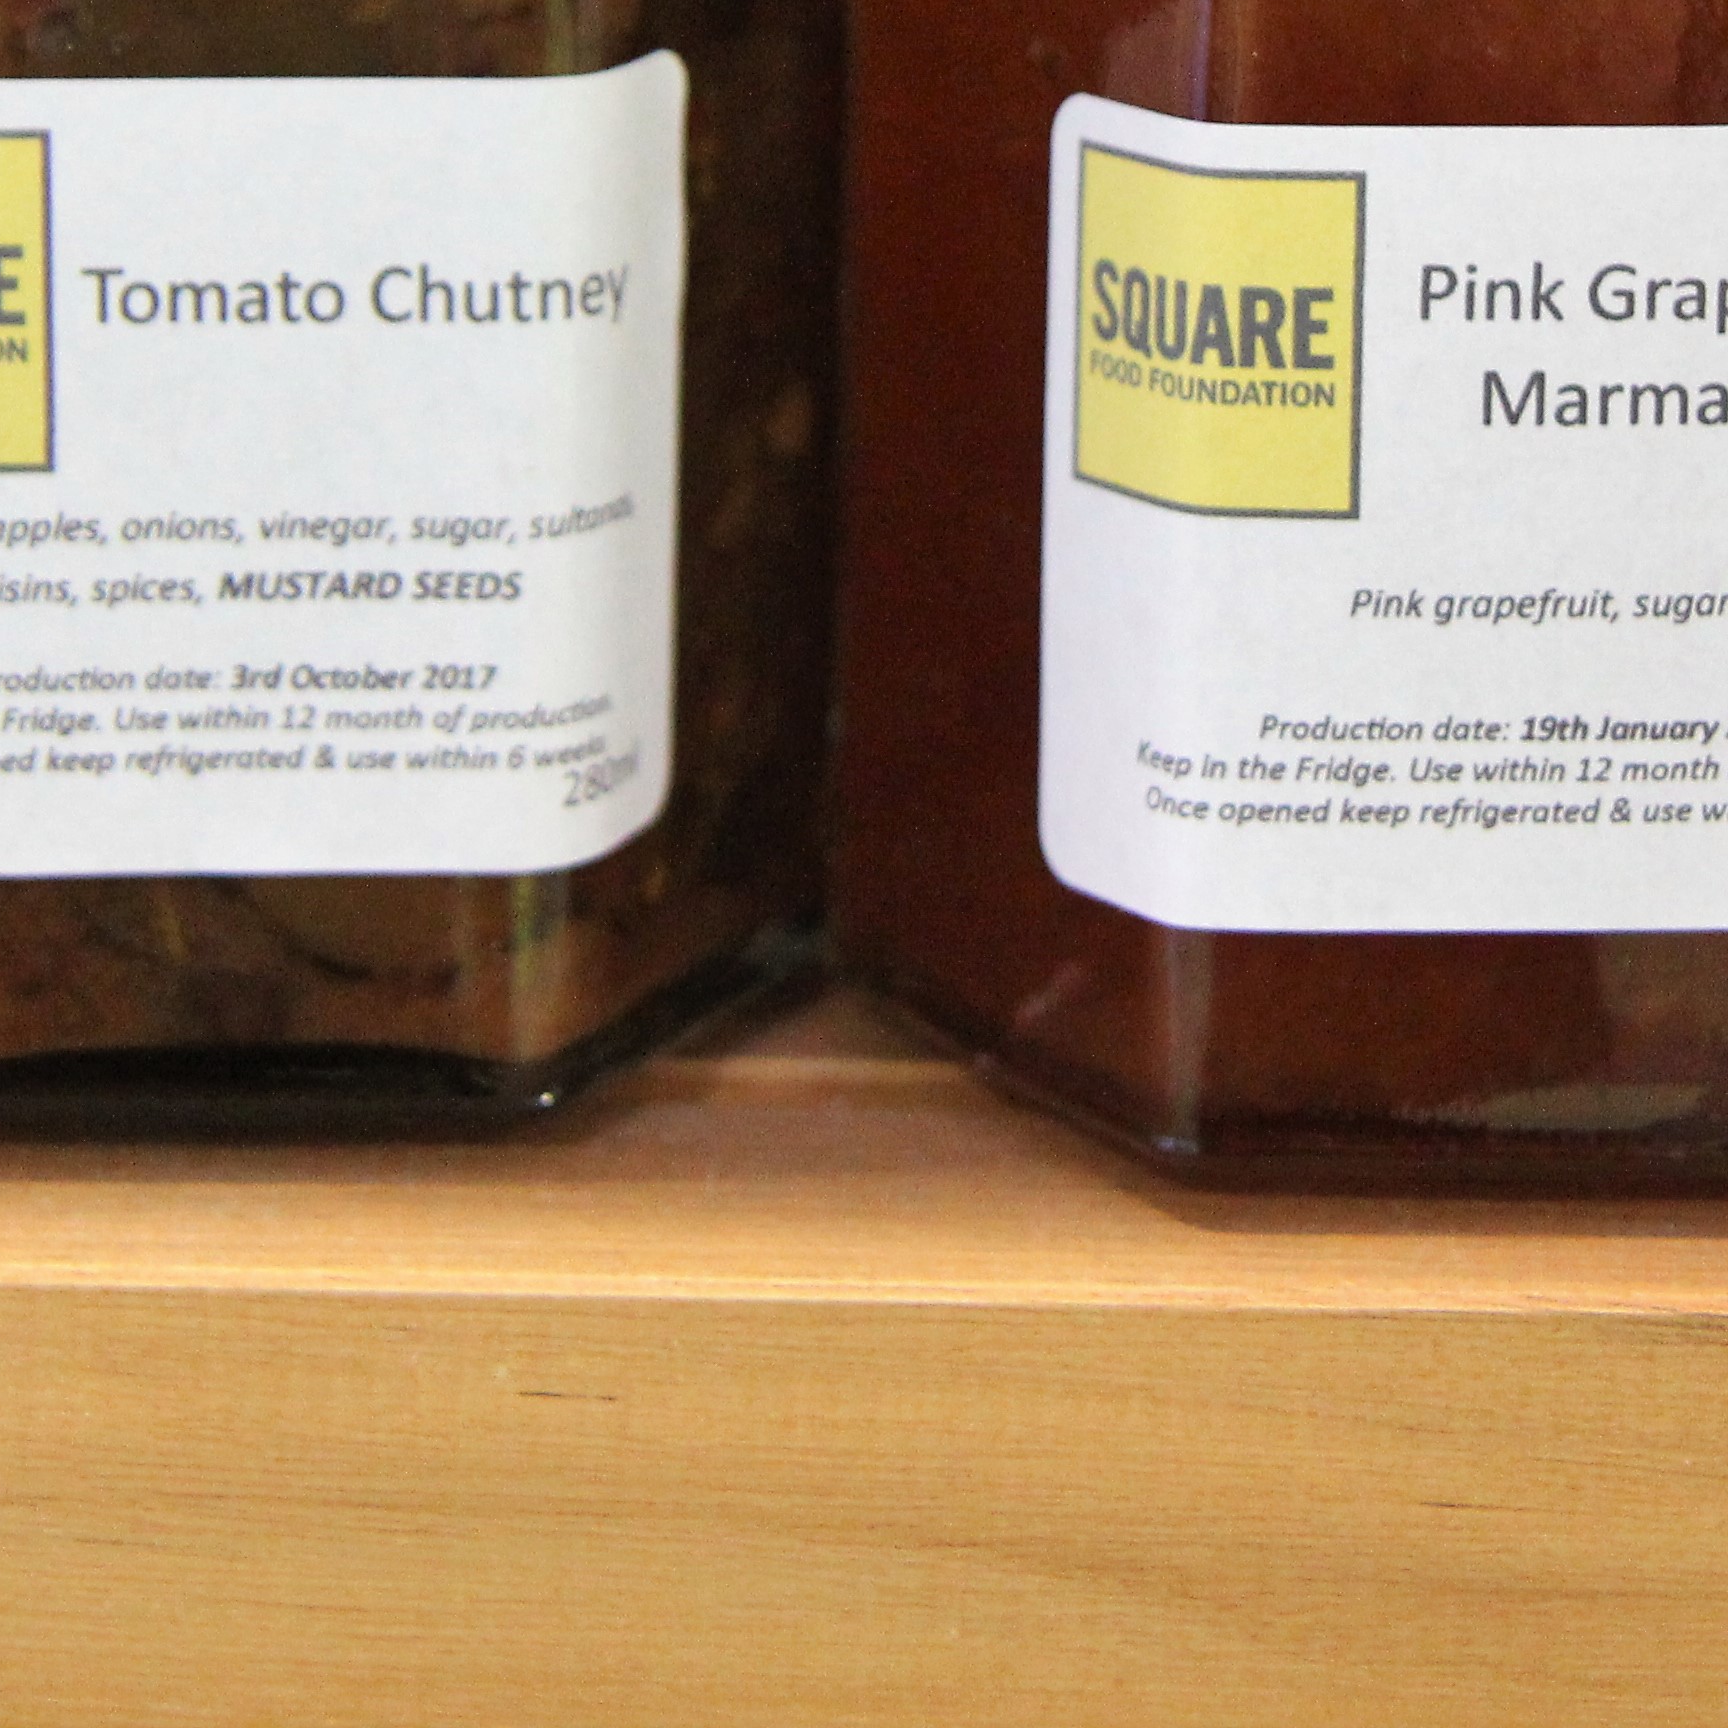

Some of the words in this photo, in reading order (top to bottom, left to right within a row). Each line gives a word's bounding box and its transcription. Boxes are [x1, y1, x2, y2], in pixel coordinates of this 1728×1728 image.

[81, 267, 346, 324] Tomato
[370, 264, 629, 324] Chutney
[1419, 262, 1565, 322] Pink
[1093, 258, 1334, 369] SQUARE
[1089, 349, 1142, 387] FOOD
[1149, 366, 1335, 407] FOUNDATION
[121, 511, 243, 544] onions,
[259, 512, 397, 547] vinegar,
[411, 514, 517, 547] sugar,
[91, 574, 202, 608] spices,
[219, 571, 402, 602] MUSTARD
[413, 571, 524, 601] SEEDS
[1350, 588, 1423, 619] Pink
[1434, 588, 1620, 625] grapefruit,
[145, 665, 220, 691] date:
[232, 664, 282, 690] 3rd
[290, 664, 413, 690] October
[422, 663, 497, 690] 2017
[1, 708, 101, 736] Fridge.
[114, 707, 168, 731] Use
[178, 703, 268, 730] within
[281, 704, 316, 730] 12
[326, 703, 422, 729] month
[432, 703, 467, 734] of
[1259, 715, 1423, 742] Production
[1432, 715, 1511, 742] date:
[1520, 714, 1588, 742] 19th
[1595, 714, 1719, 745] January
[47, 748, 116, 775] keep
[124, 746, 305, 775] refrigerated
[315, 743, 335, 769] &
[346, 750, 396, 769] use
[405, 744, 498, 769] within
[507, 744, 525, 768] 6
[1137, 739, 1192, 779] Keep
[1202, 752, 1227, 780] in
[1238, 756, 1287, 782] the
[1295, 755, 1396, 788] Fridge.
[1408, 757, 1464, 782] Use
[1472, 755, 1565, 783] within
[1575, 757, 1612, 783] 12
[1621, 754, 1718, 782] month
[1146, 785, 1210, 821] Once
[1218, 797, 1332, 827] opened
[1340, 797, 1409, 828] keep
[1419, 798, 1599, 830] refrigerated
[1610, 798, 1631, 824] &
[1643, 803, 1693, 823] use
